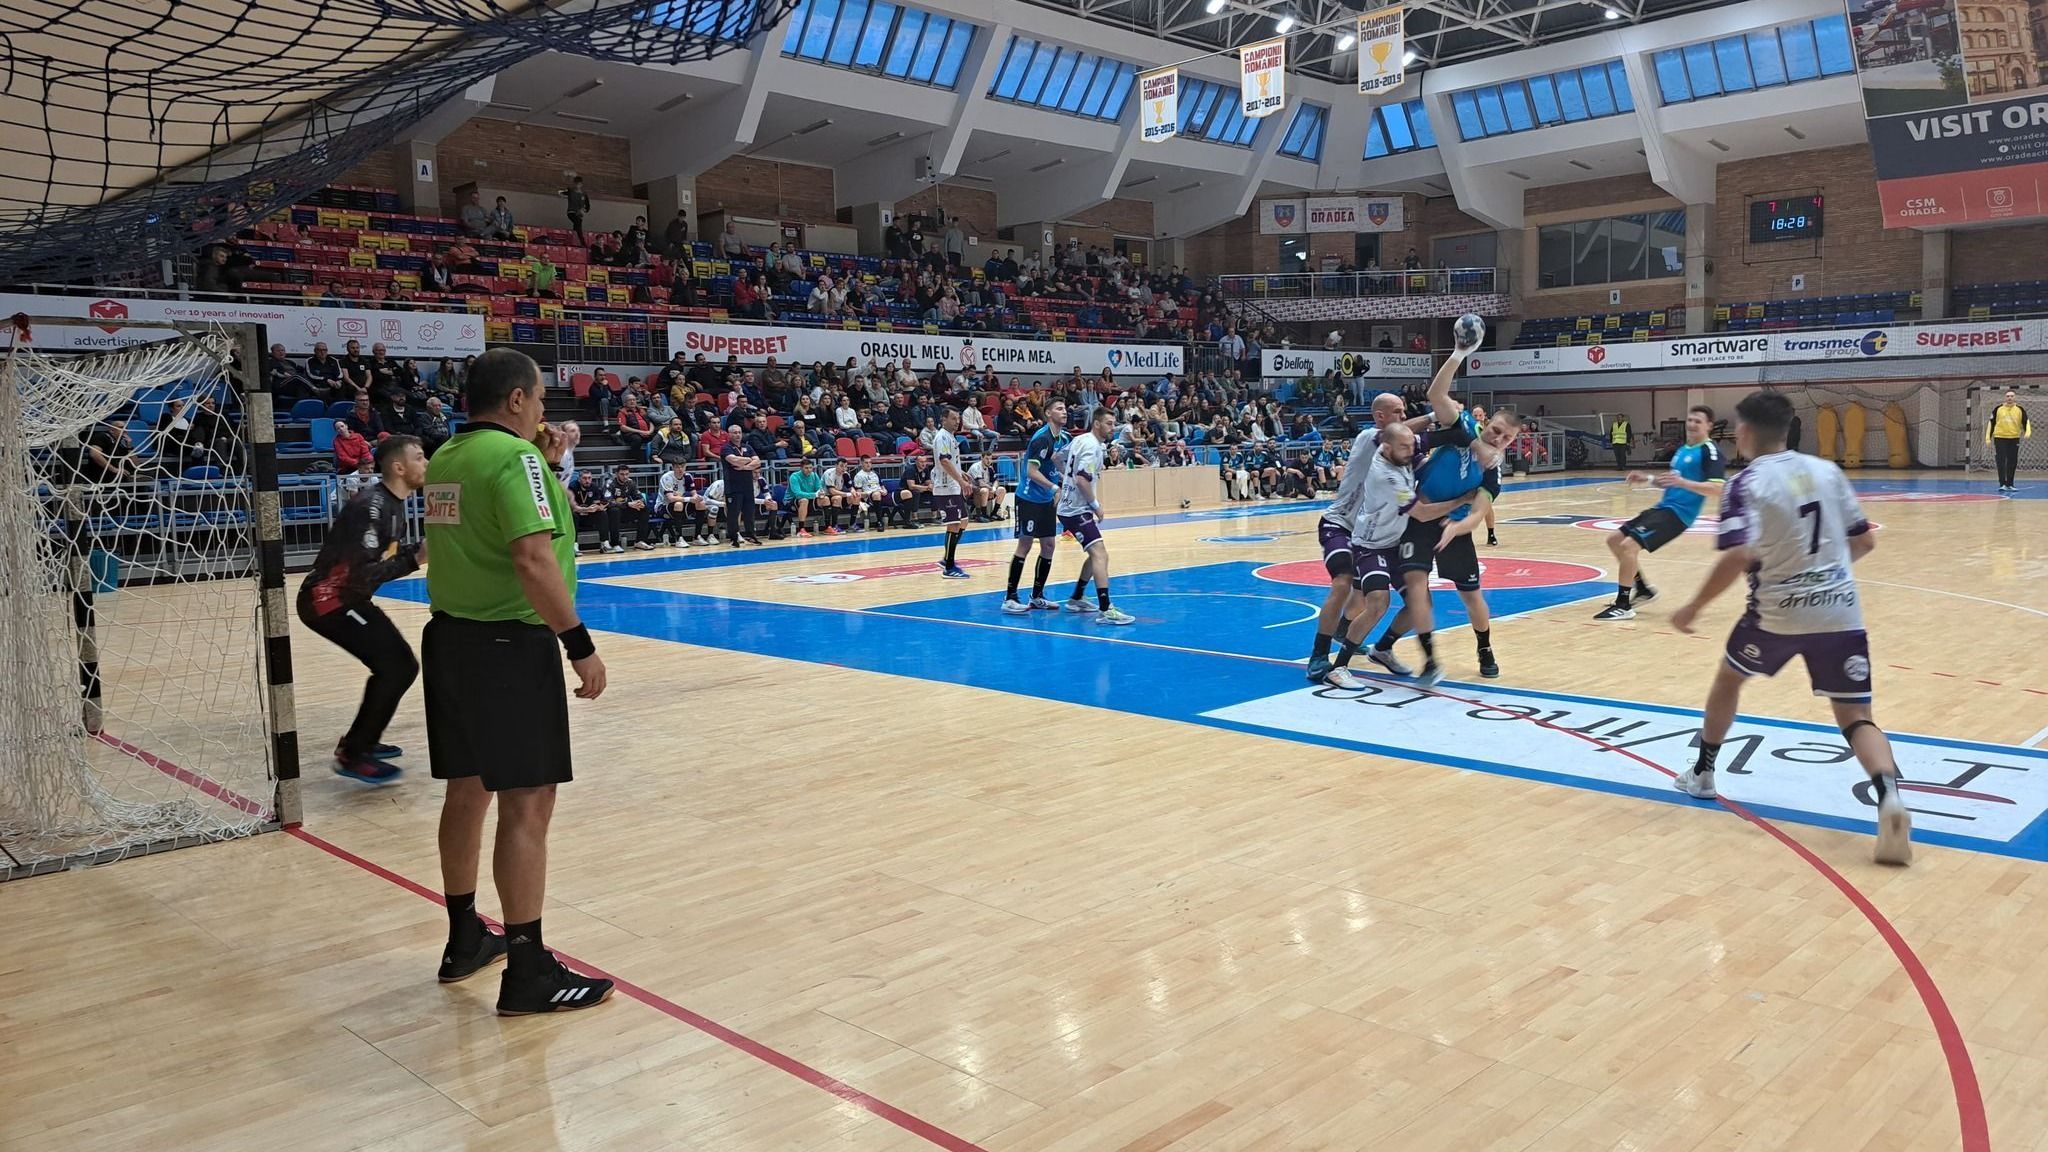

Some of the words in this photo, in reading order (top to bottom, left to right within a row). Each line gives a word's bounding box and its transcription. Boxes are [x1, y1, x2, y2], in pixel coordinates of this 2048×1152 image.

[1361, 12, 1401, 31] CAMPIONII
[1244, 45, 1282, 63] CAMPIONII
[1143, 73, 1175, 90] CAMPIONII
[1360, 73, 1402, 91] 2018-2019
[1246, 96, 1281, 112] 2017-2018
[1144, 123, 1175, 137] 2015-2016
[1906, 111, 1993, 142] VISIT
[2011, 143, 2032, 151] Visit
[421, 164, 429, 176] A
[1768, 201, 1776, 212] 7
[1812, 197, 1822, 207] 4
[1906, 198, 1936, 208] CSM
[1311, 211, 1354, 223] ORADEA
[1900, 206, 1946, 217] ORADEA
[164, 307, 186, 316] Over
[201, 309, 226, 318] years
[228, 309, 237, 317] of
[239, 310, 285, 319] innovation
[1916, 327, 2023, 347] SUPERBET
[686, 331, 788, 355] SUPERBET
[922, 345, 954, 360] MEU.
[982, 347, 1024, 362] ECHIPA
[1028, 349, 1056, 364] MEA.
[1124, 351, 1180, 368] MedLife
[1671, 338, 1768, 356] smartware
[1783, 338, 1861, 351] transmec
[1824, 348, 1861, 358] group
[1284, 356, 1314, 370] bellotto
[1600, 361, 1632, 369] advertising
[560, 367, 566, 381] E
[1026, 519, 1034, 532] 8
[1799, 500, 1821, 555] 7
[346, 609, 368, 625] 1
